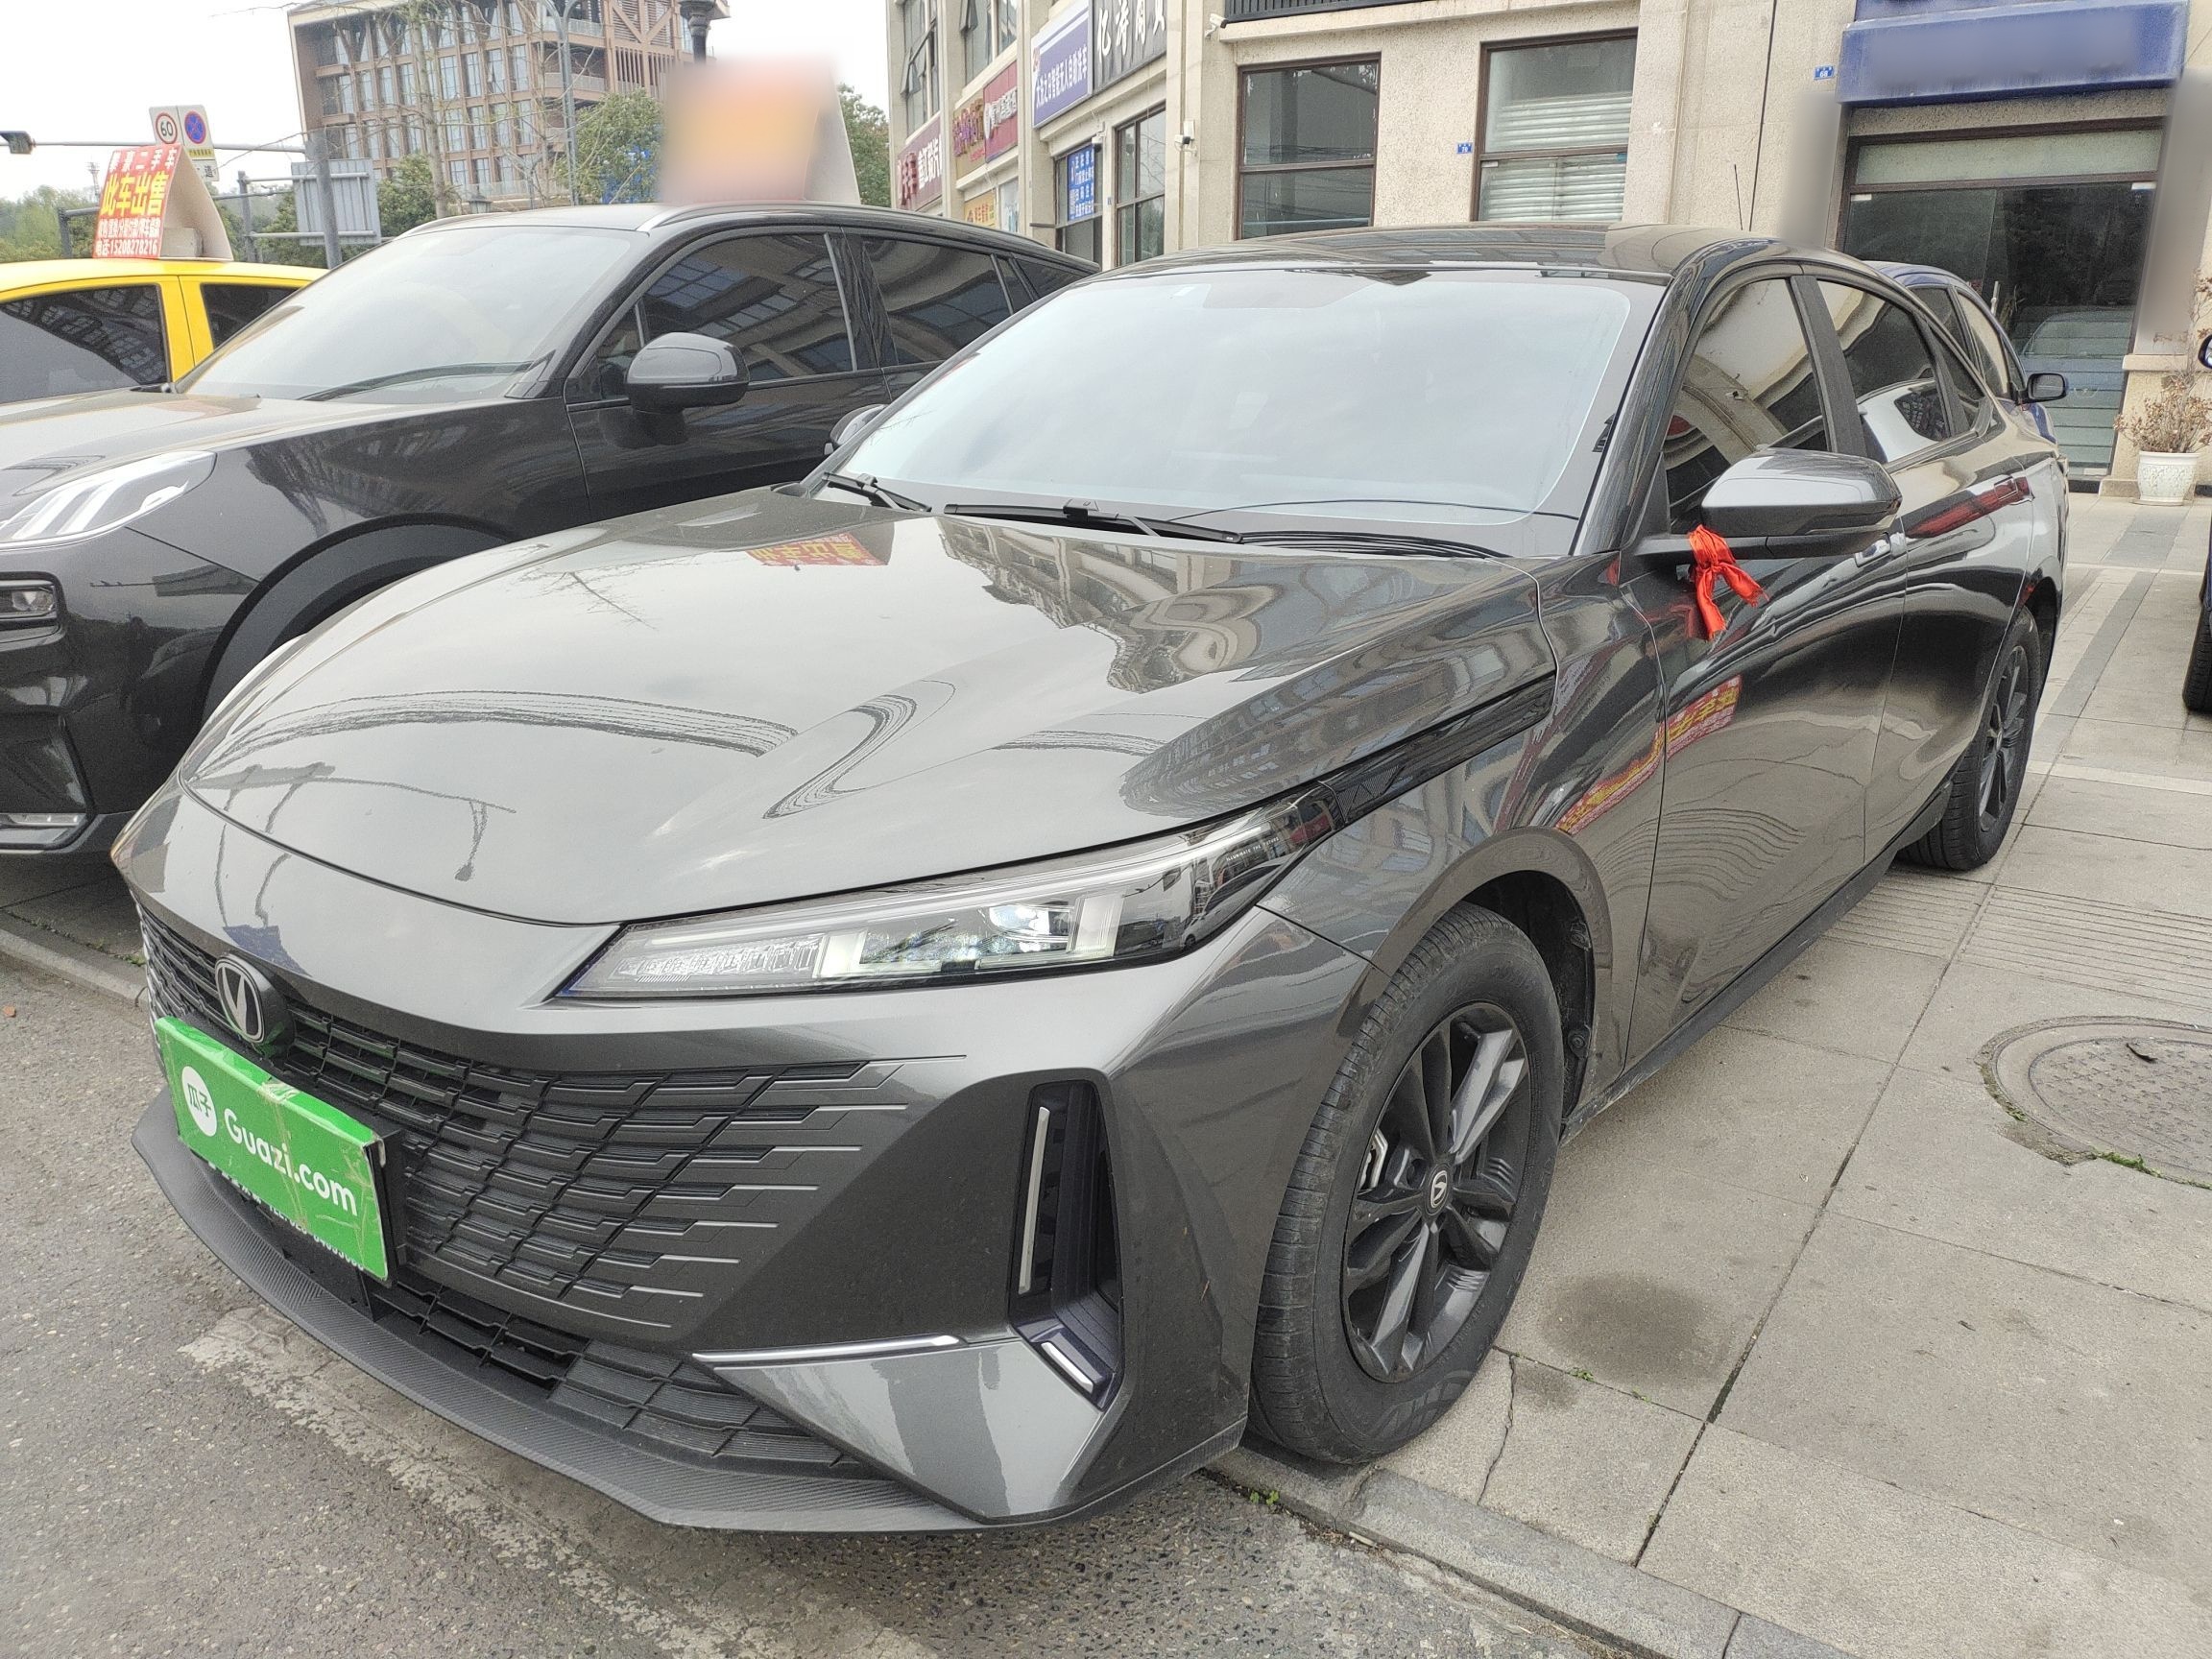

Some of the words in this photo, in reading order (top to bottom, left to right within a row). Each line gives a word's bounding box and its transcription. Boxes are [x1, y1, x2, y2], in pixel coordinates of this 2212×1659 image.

[160, 121, 174, 136] 60
[100, 170, 169, 216] 此车出售
[224, 1108, 358, 1215] Guazi.com
